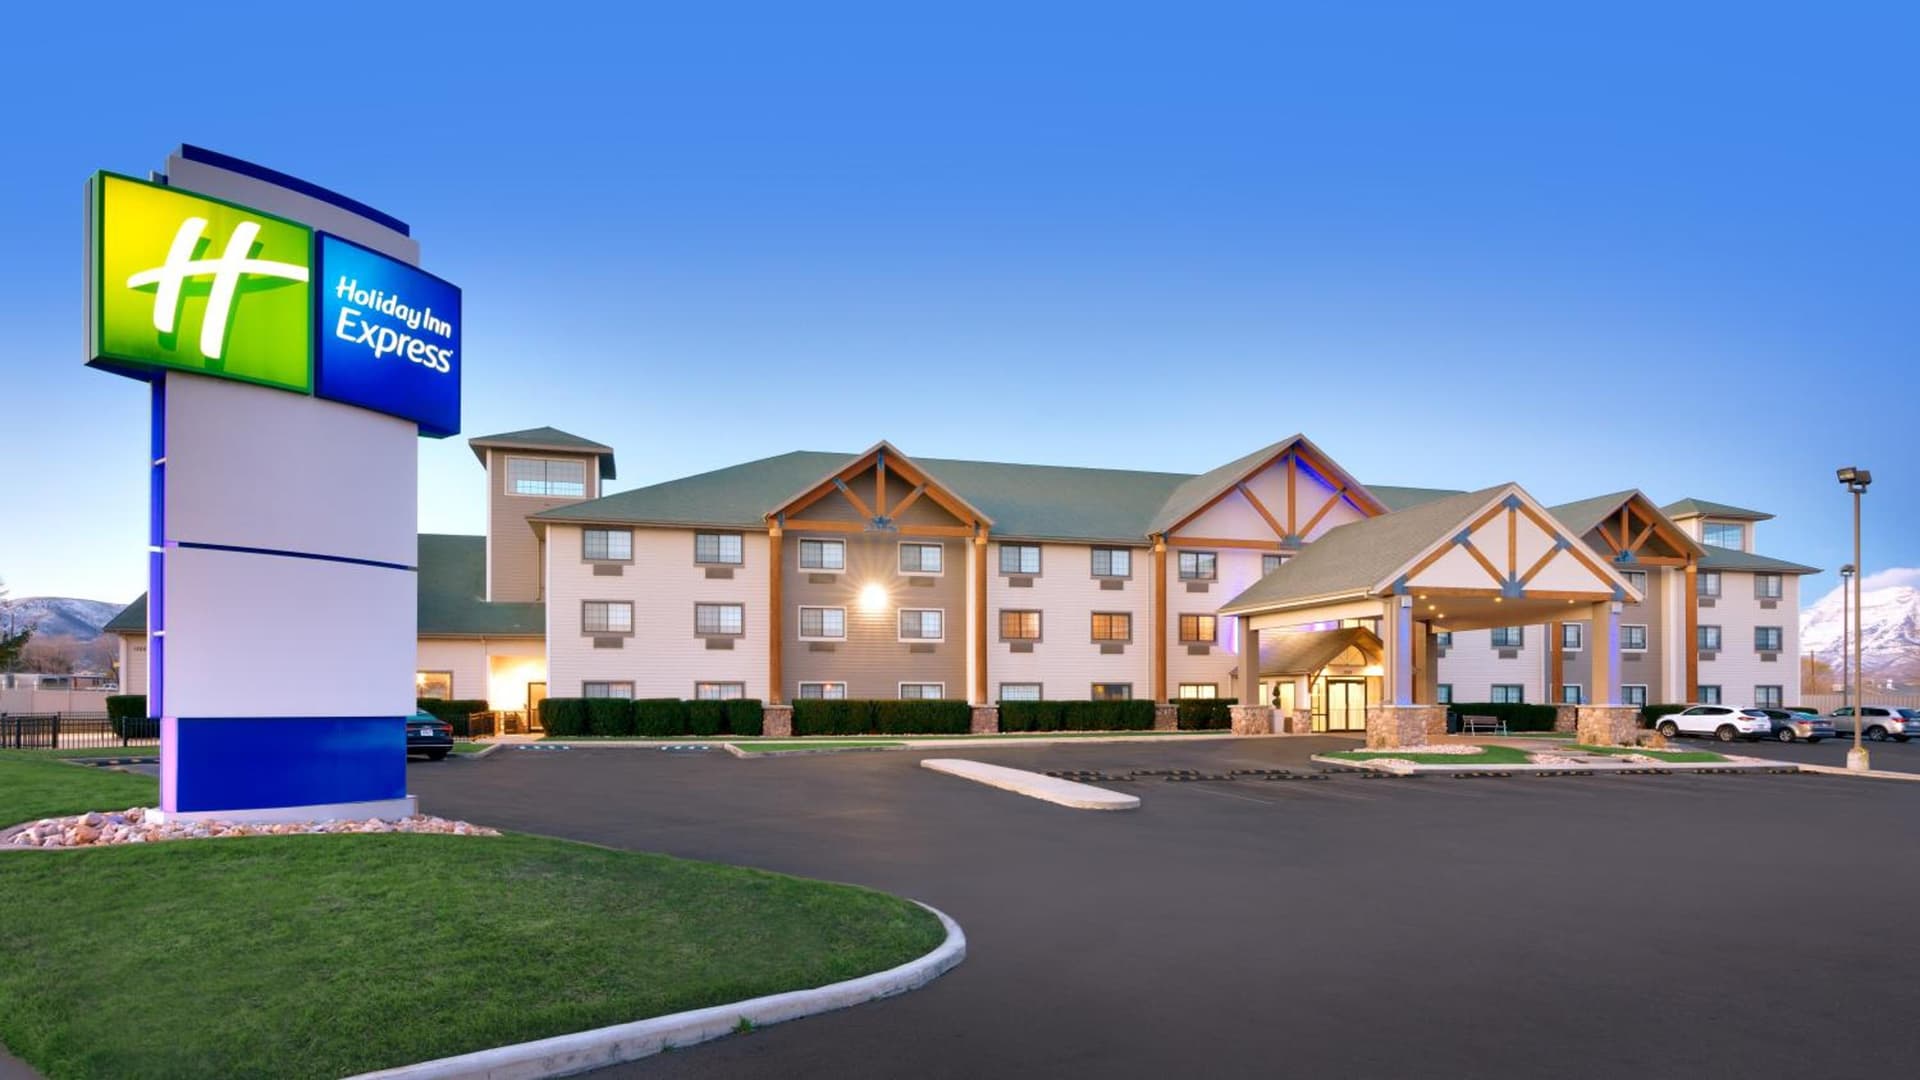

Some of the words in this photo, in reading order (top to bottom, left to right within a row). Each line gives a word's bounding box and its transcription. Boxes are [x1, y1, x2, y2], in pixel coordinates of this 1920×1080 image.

[126, 216, 309, 360] H
[336, 275, 421, 330] Holiday
[423, 307, 452, 339] Inn
[335, 306, 451, 373] Express
